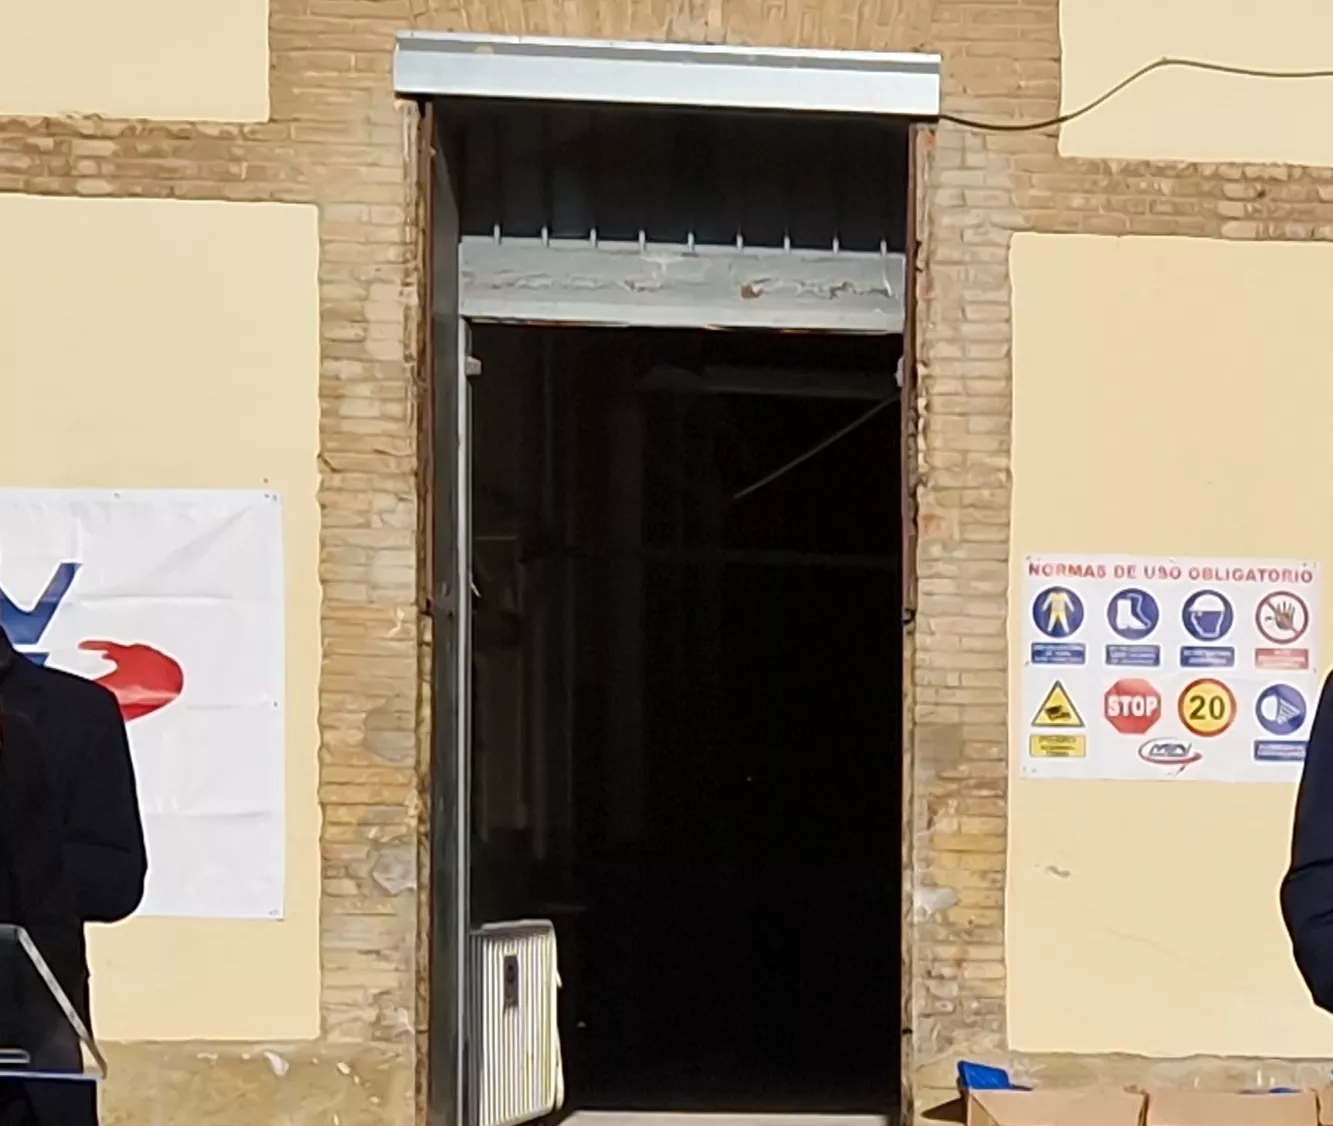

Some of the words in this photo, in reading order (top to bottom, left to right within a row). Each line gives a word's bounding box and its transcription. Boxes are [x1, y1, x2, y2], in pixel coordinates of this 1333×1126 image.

[1028, 563, 1107, 579] NORMAS
[1114, 565, 1136, 579] DE
[1144, 565, 1181, 580] USO
[1188, 566, 1313, 583] OBLIGATORIO
[1107, 695, 1159, 717] STOP
[1189, 695, 1226, 721] 20
